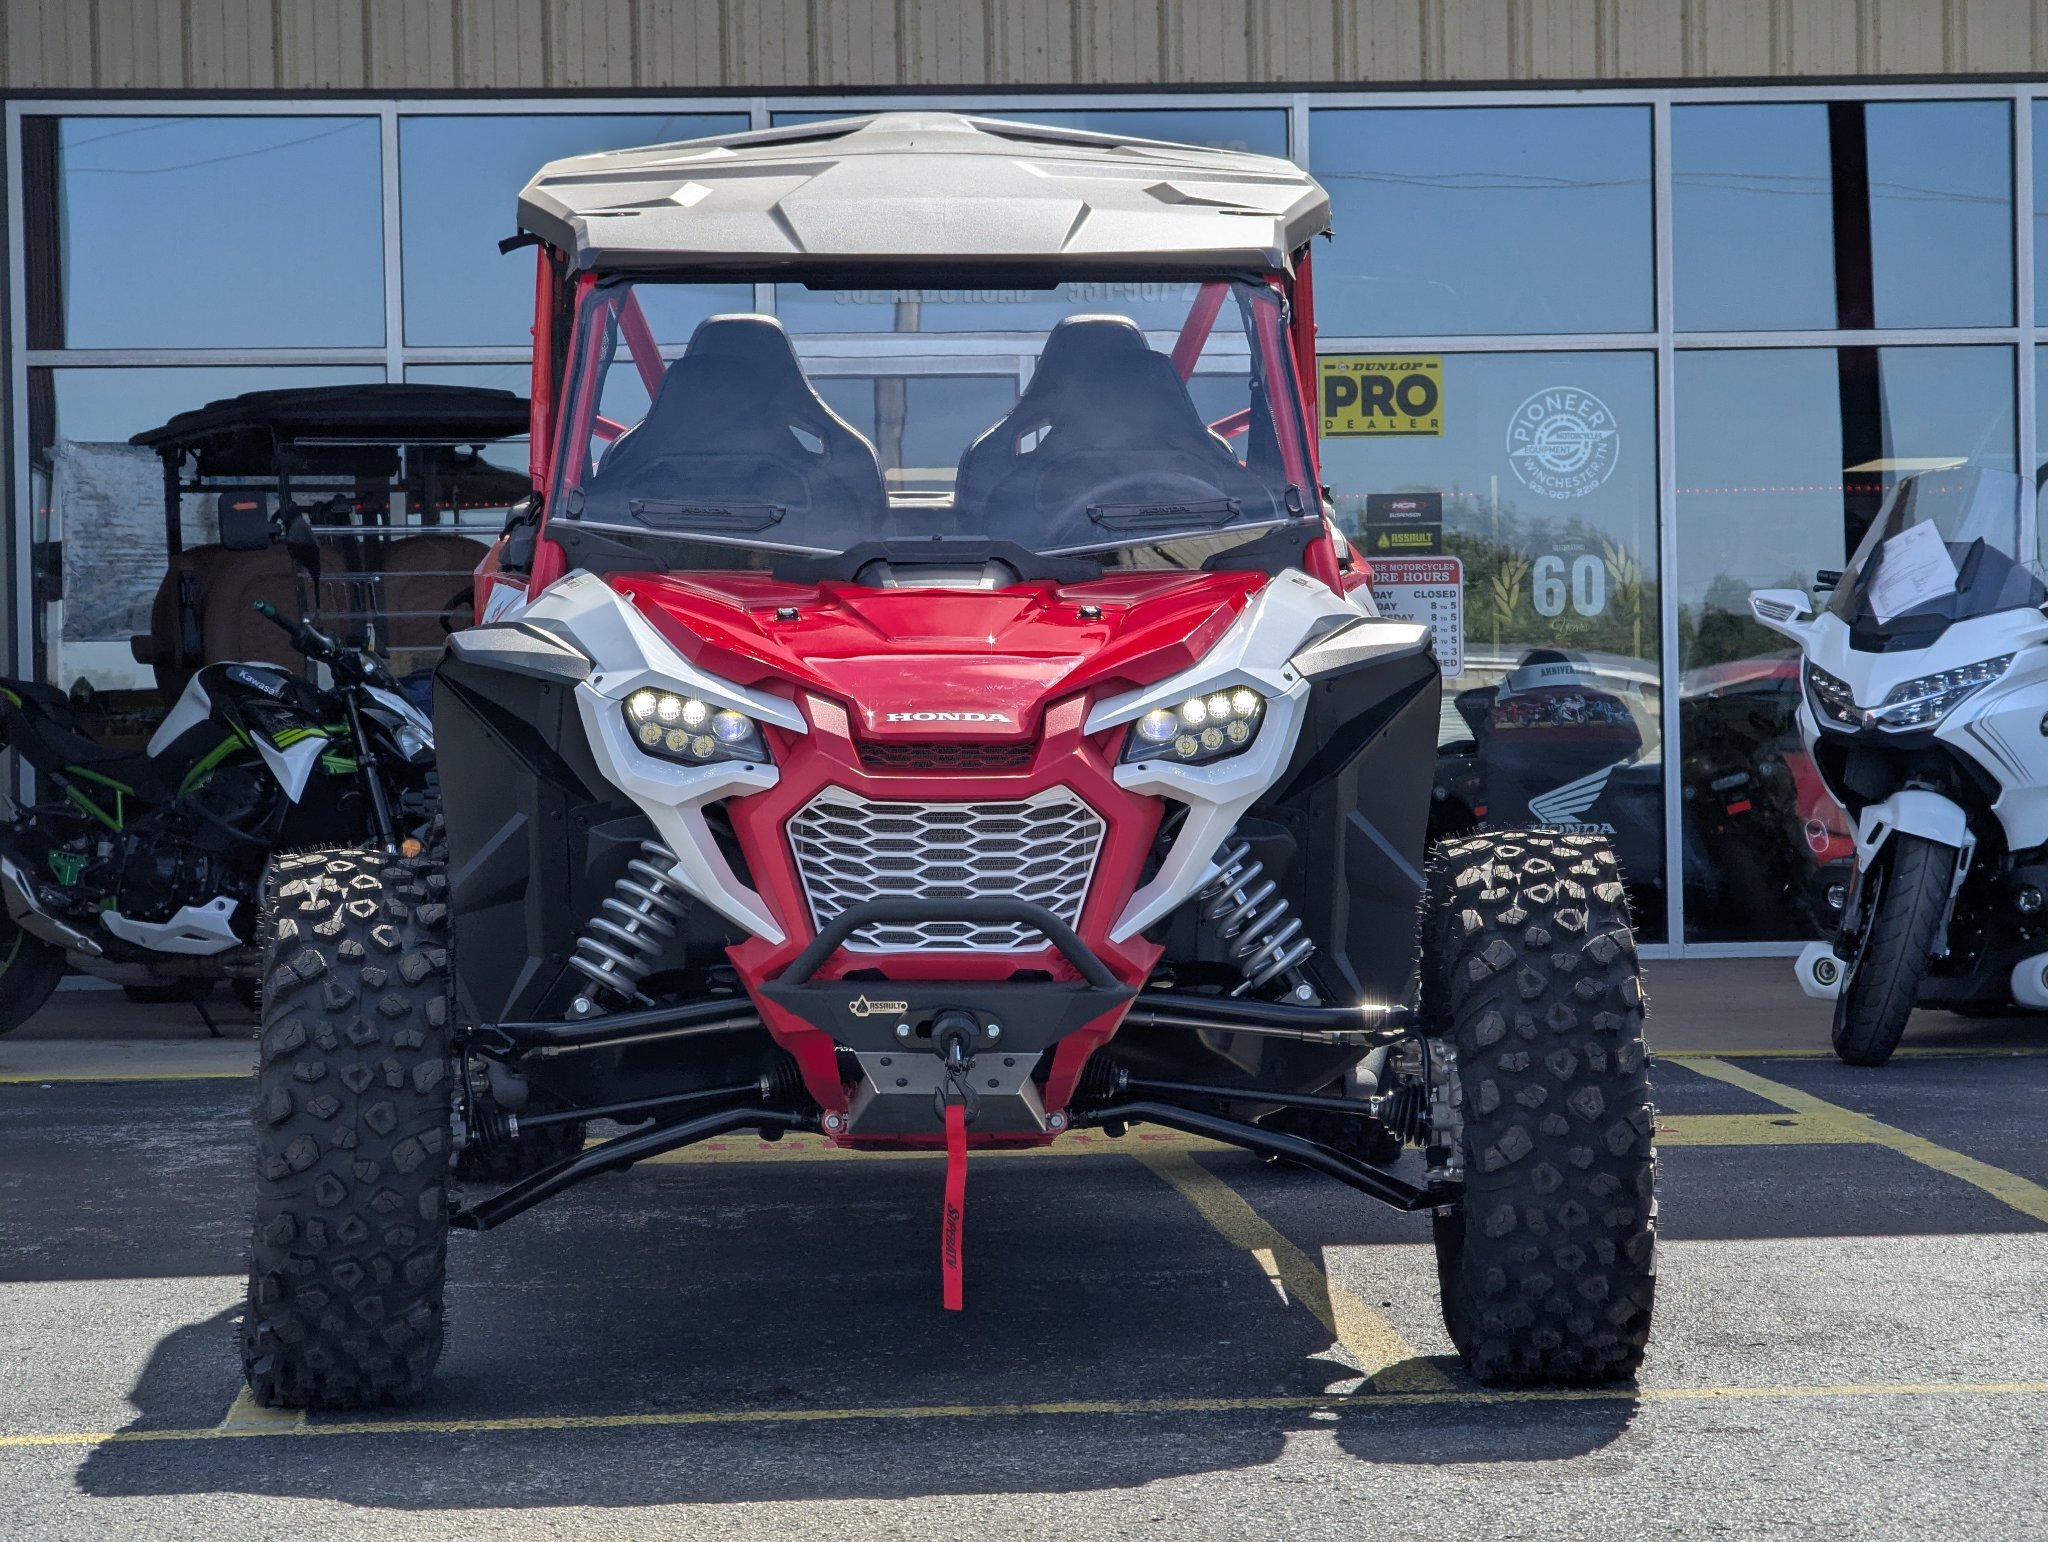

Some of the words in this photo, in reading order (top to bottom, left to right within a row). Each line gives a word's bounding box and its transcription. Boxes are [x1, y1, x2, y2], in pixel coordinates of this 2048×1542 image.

[1351, 362, 1424, 371] DUNLOP
[1324, 373, 1439, 418] PRO
[1514, 393, 1606, 442] PIONEER
[1325, 418, 1440, 430] DEALER
[1524, 446, 1571, 454] EQUIPMENT
[1391, 533, 1433, 543] ASSAULT
[1390, 563, 1455, 571] MOTORCYCLES
[1403, 571, 1450, 582] HOURS
[1532, 554, 1606, 617] 60
[1413, 590, 1457, 599] CLOSED
[1430, 602, 1437, 610] 8
[1450, 602, 1457, 610] 5
[1431, 613, 1438, 621] 8
[1450, 613, 1457, 621] 5
[1431, 625, 1438, 633] 8
[1450, 625, 1457, 633] 5
[1451, 636, 1457, 644] 5
[1451, 647, 1458, 656] 3
[1541, 665, 1597, 678] ANNIVER
[886, 712, 1013, 723] HONDA
[870, 1002, 902, 1010] ASSAULT
